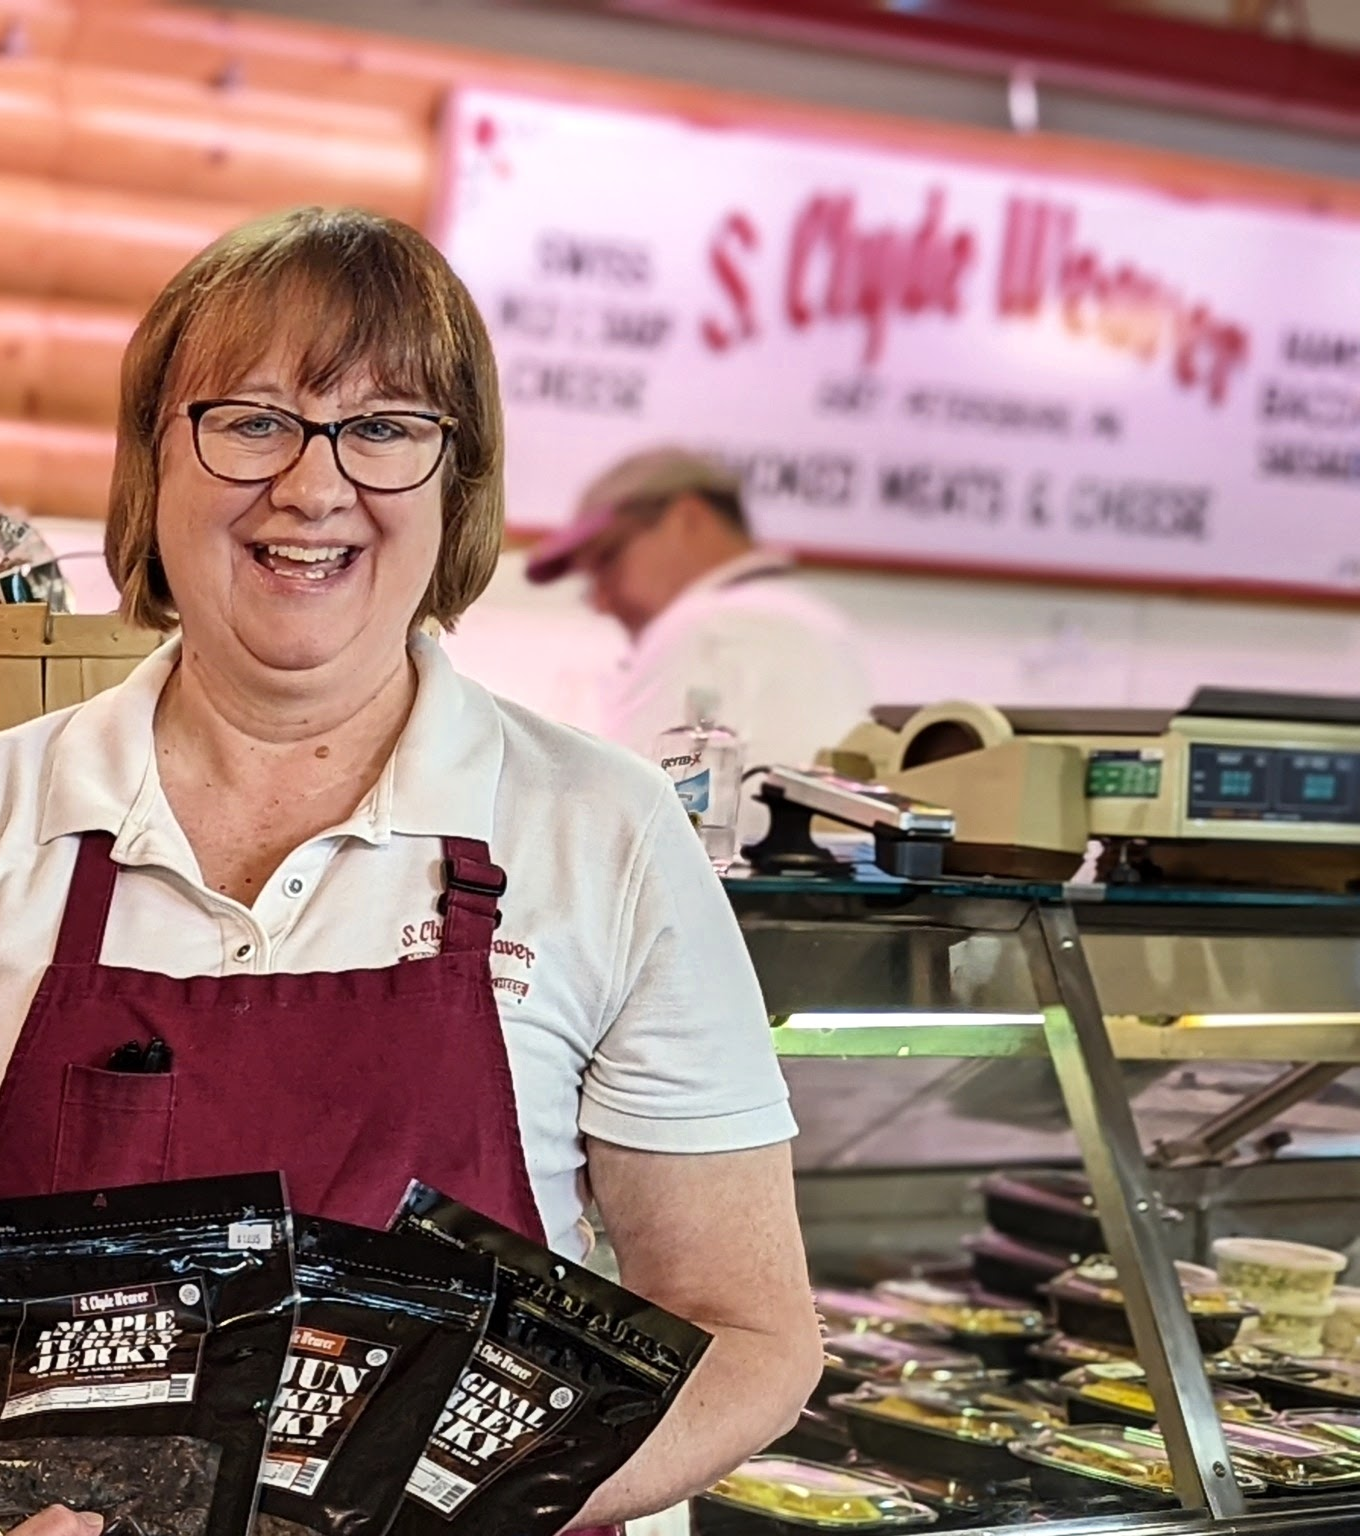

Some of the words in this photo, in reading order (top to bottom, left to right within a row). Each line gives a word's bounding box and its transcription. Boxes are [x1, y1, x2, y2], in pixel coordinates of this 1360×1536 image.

[785, 188, 976, 368] Clyde
[996, 192, 1252, 407] Weaver
[510, 358, 646, 420] CHEESE
[881, 463, 1005, 525] MEATS
[1071, 475, 1213, 543] CHEESE
[493, 939, 536, 969] aver
[56, 1310, 176, 1332] MAPLE
[29, 1343, 178, 1374] JERKY
[35, 1329, 183, 1355] TURKEY
[281, 1356, 371, 1394] JUN
[458, 1366, 548, 1428] GINAL
